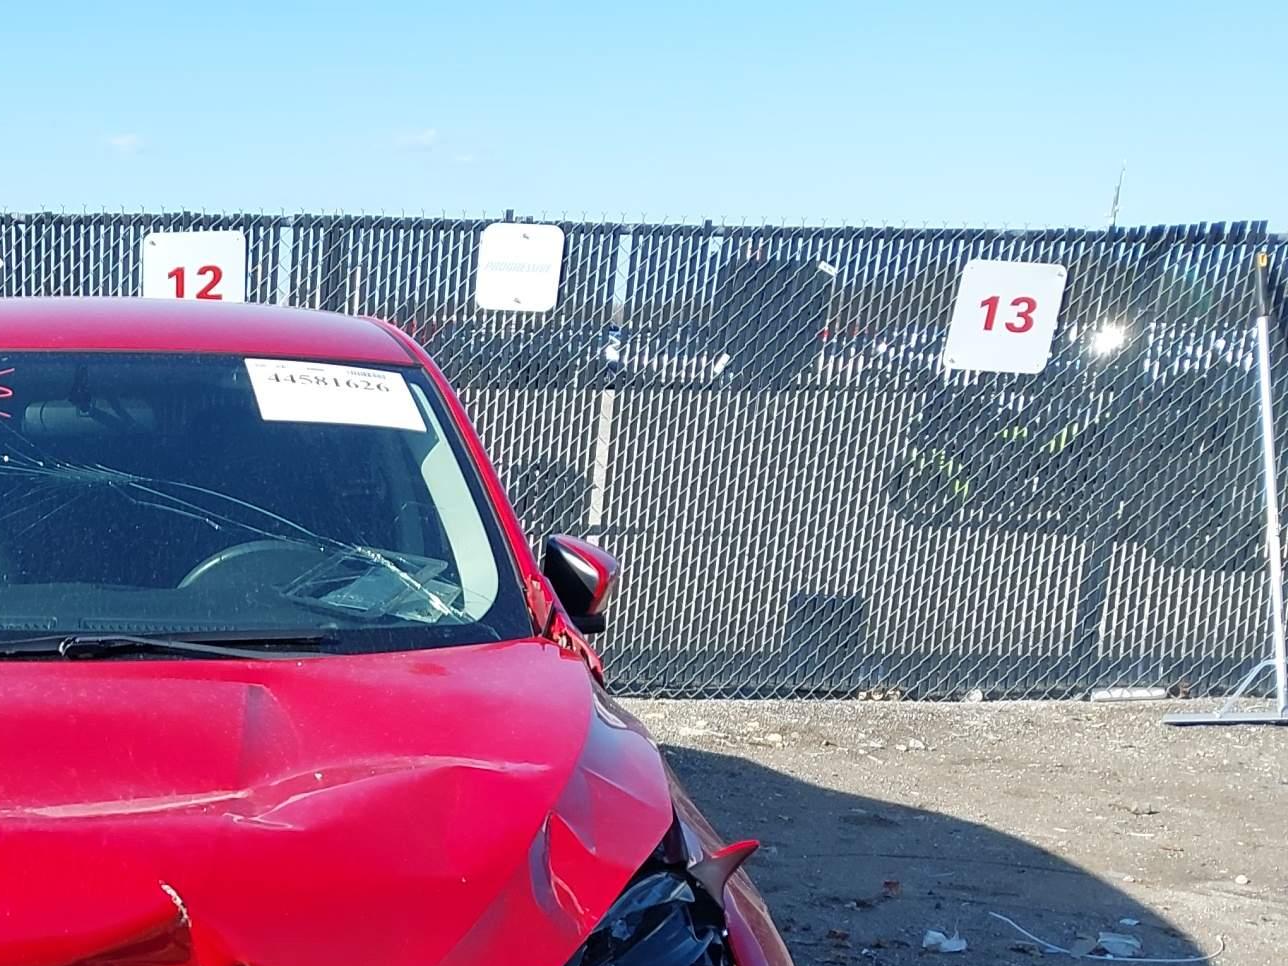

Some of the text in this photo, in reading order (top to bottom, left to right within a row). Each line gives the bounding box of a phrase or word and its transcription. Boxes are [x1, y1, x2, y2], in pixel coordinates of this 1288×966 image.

[167, 264, 224, 300] 12
[978, 295, 1038, 334] 13
[267, 372, 390, 392] 44581626
